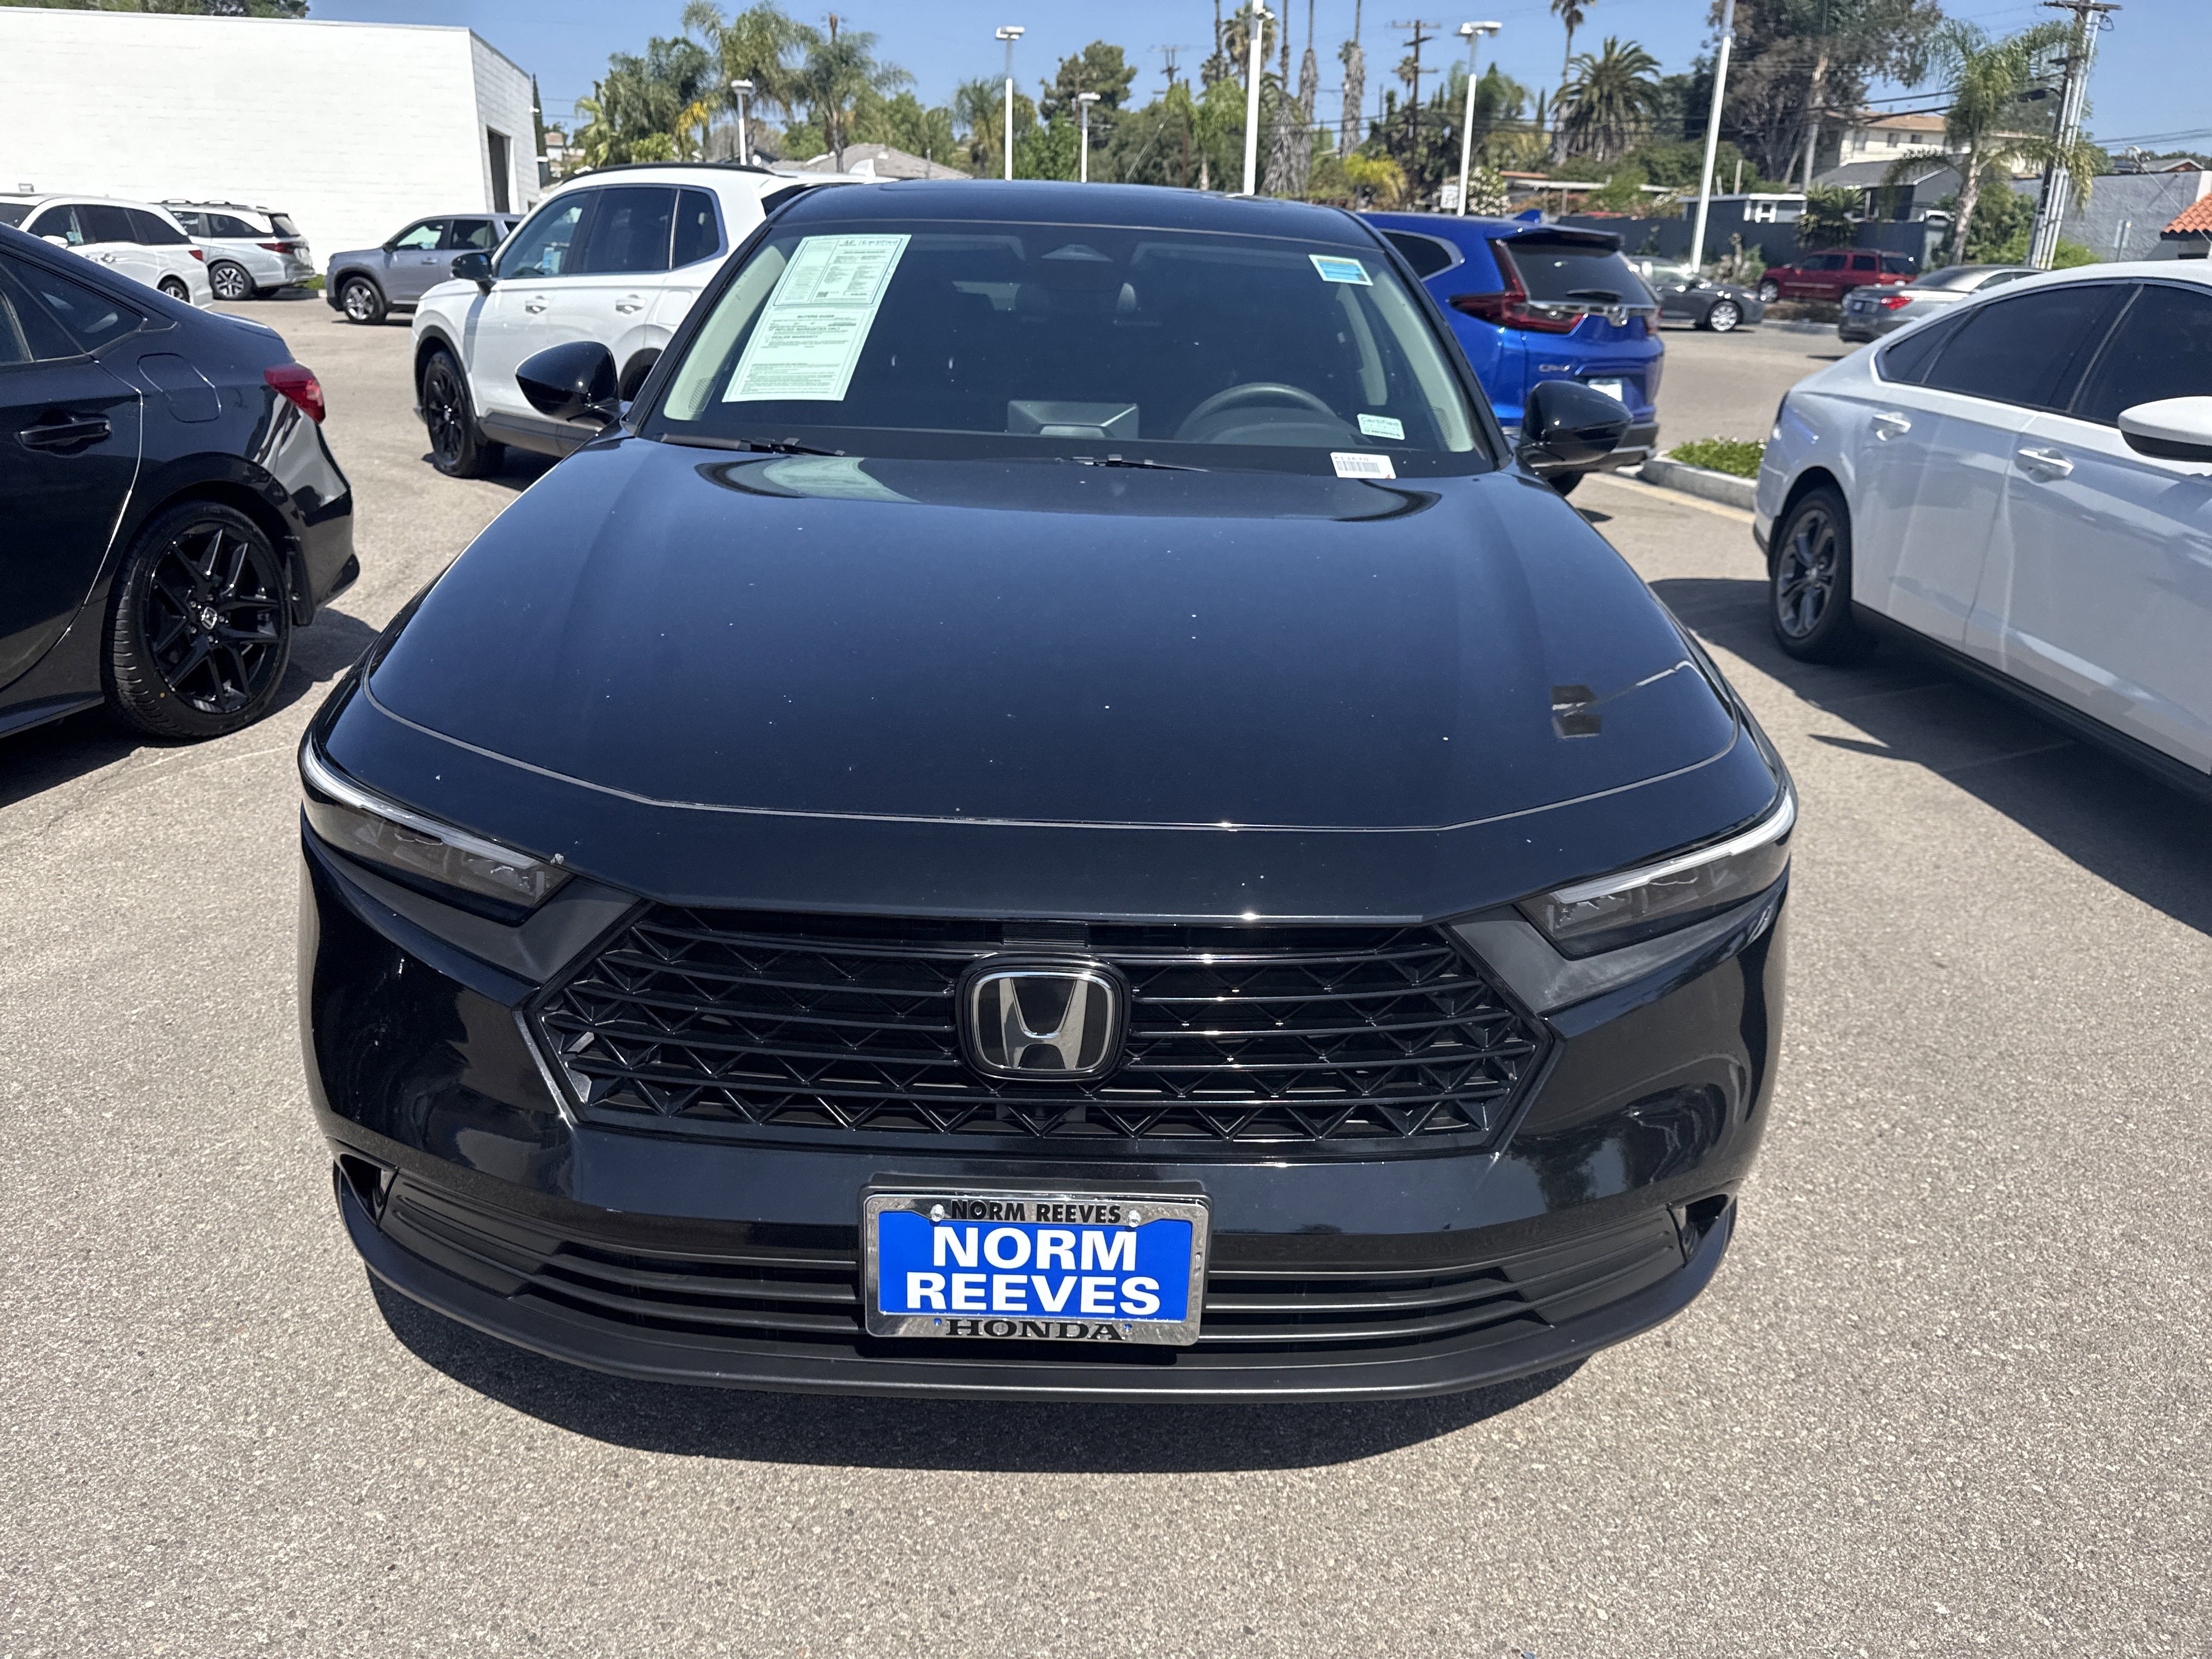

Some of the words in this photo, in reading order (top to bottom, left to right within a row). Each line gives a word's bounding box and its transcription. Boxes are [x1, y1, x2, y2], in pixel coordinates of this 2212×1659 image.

[951, 1200, 1025, 1222] NORM
[1037, 1203, 1121, 1224] REEVES
[933, 1226, 1137, 1271] NORM
[906, 1272, 1160, 1316] REEVES
[947, 1318, 1125, 1341] HONDA
